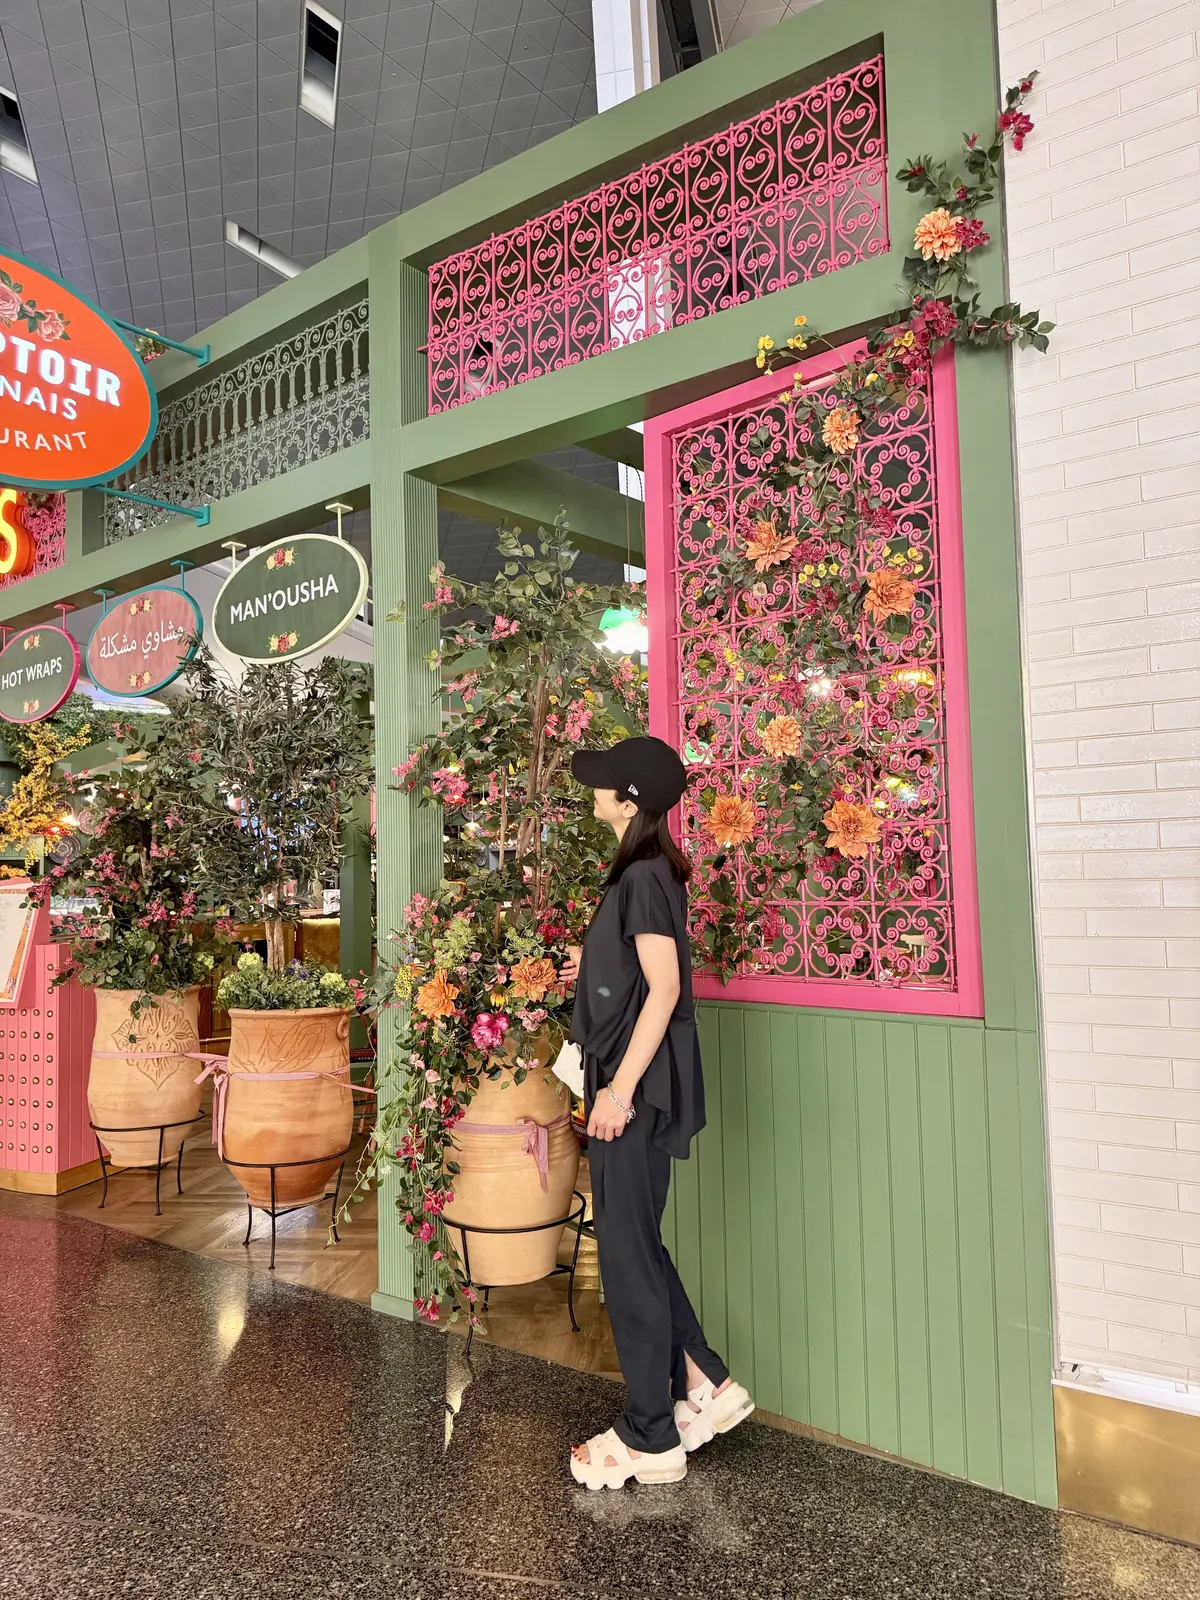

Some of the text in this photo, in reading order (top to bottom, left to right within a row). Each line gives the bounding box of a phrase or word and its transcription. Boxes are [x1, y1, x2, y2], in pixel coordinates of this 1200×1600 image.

[230, 573, 339, 625] MAN’OUSHA
[99, 619, 184, 660] مشاوي مشكلة
[1, 656, 62, 690] HOT WRAPS
